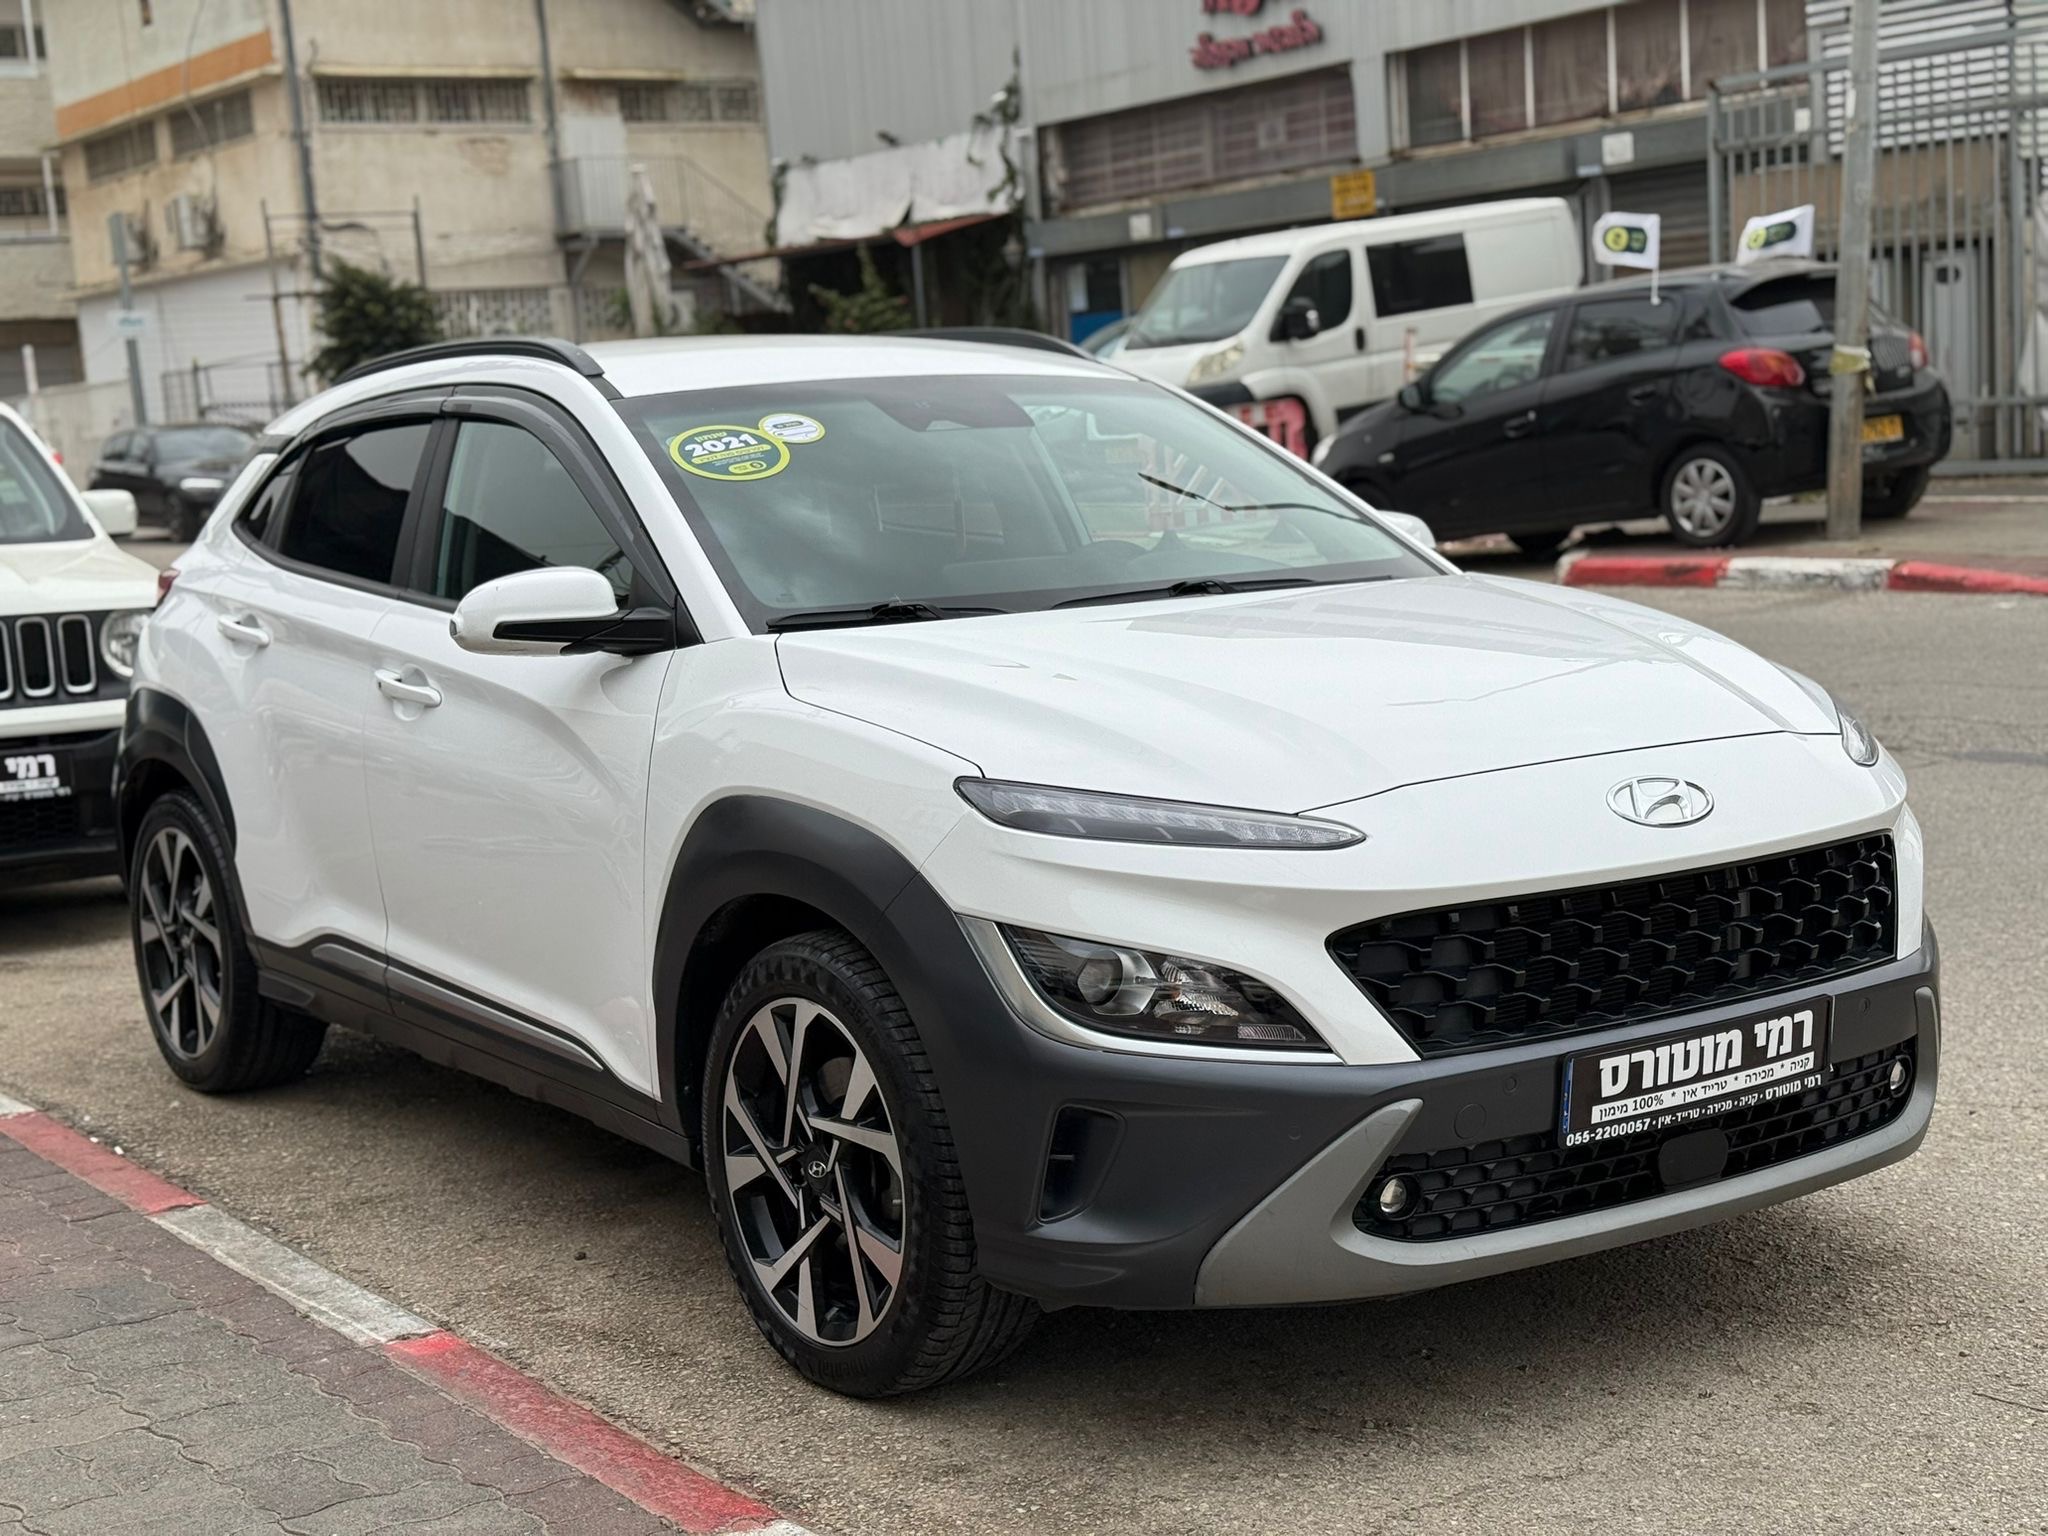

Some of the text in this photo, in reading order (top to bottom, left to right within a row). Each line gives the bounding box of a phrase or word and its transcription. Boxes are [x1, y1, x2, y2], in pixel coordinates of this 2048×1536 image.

[685, 433, 759, 457] 2021
[694, 431, 728, 444] שנתון
[4, 753, 56, 779] רמי
[1600, 1009, 1813, 1098] רמי מוטורס
[1566, 1073, 1822, 1147] רמי מוטורס קניה מכירה טרייד-אין 055-2200057
[1599, 1056, 1810, 1121] קניה מכירה טרייד אין 100% מימון
